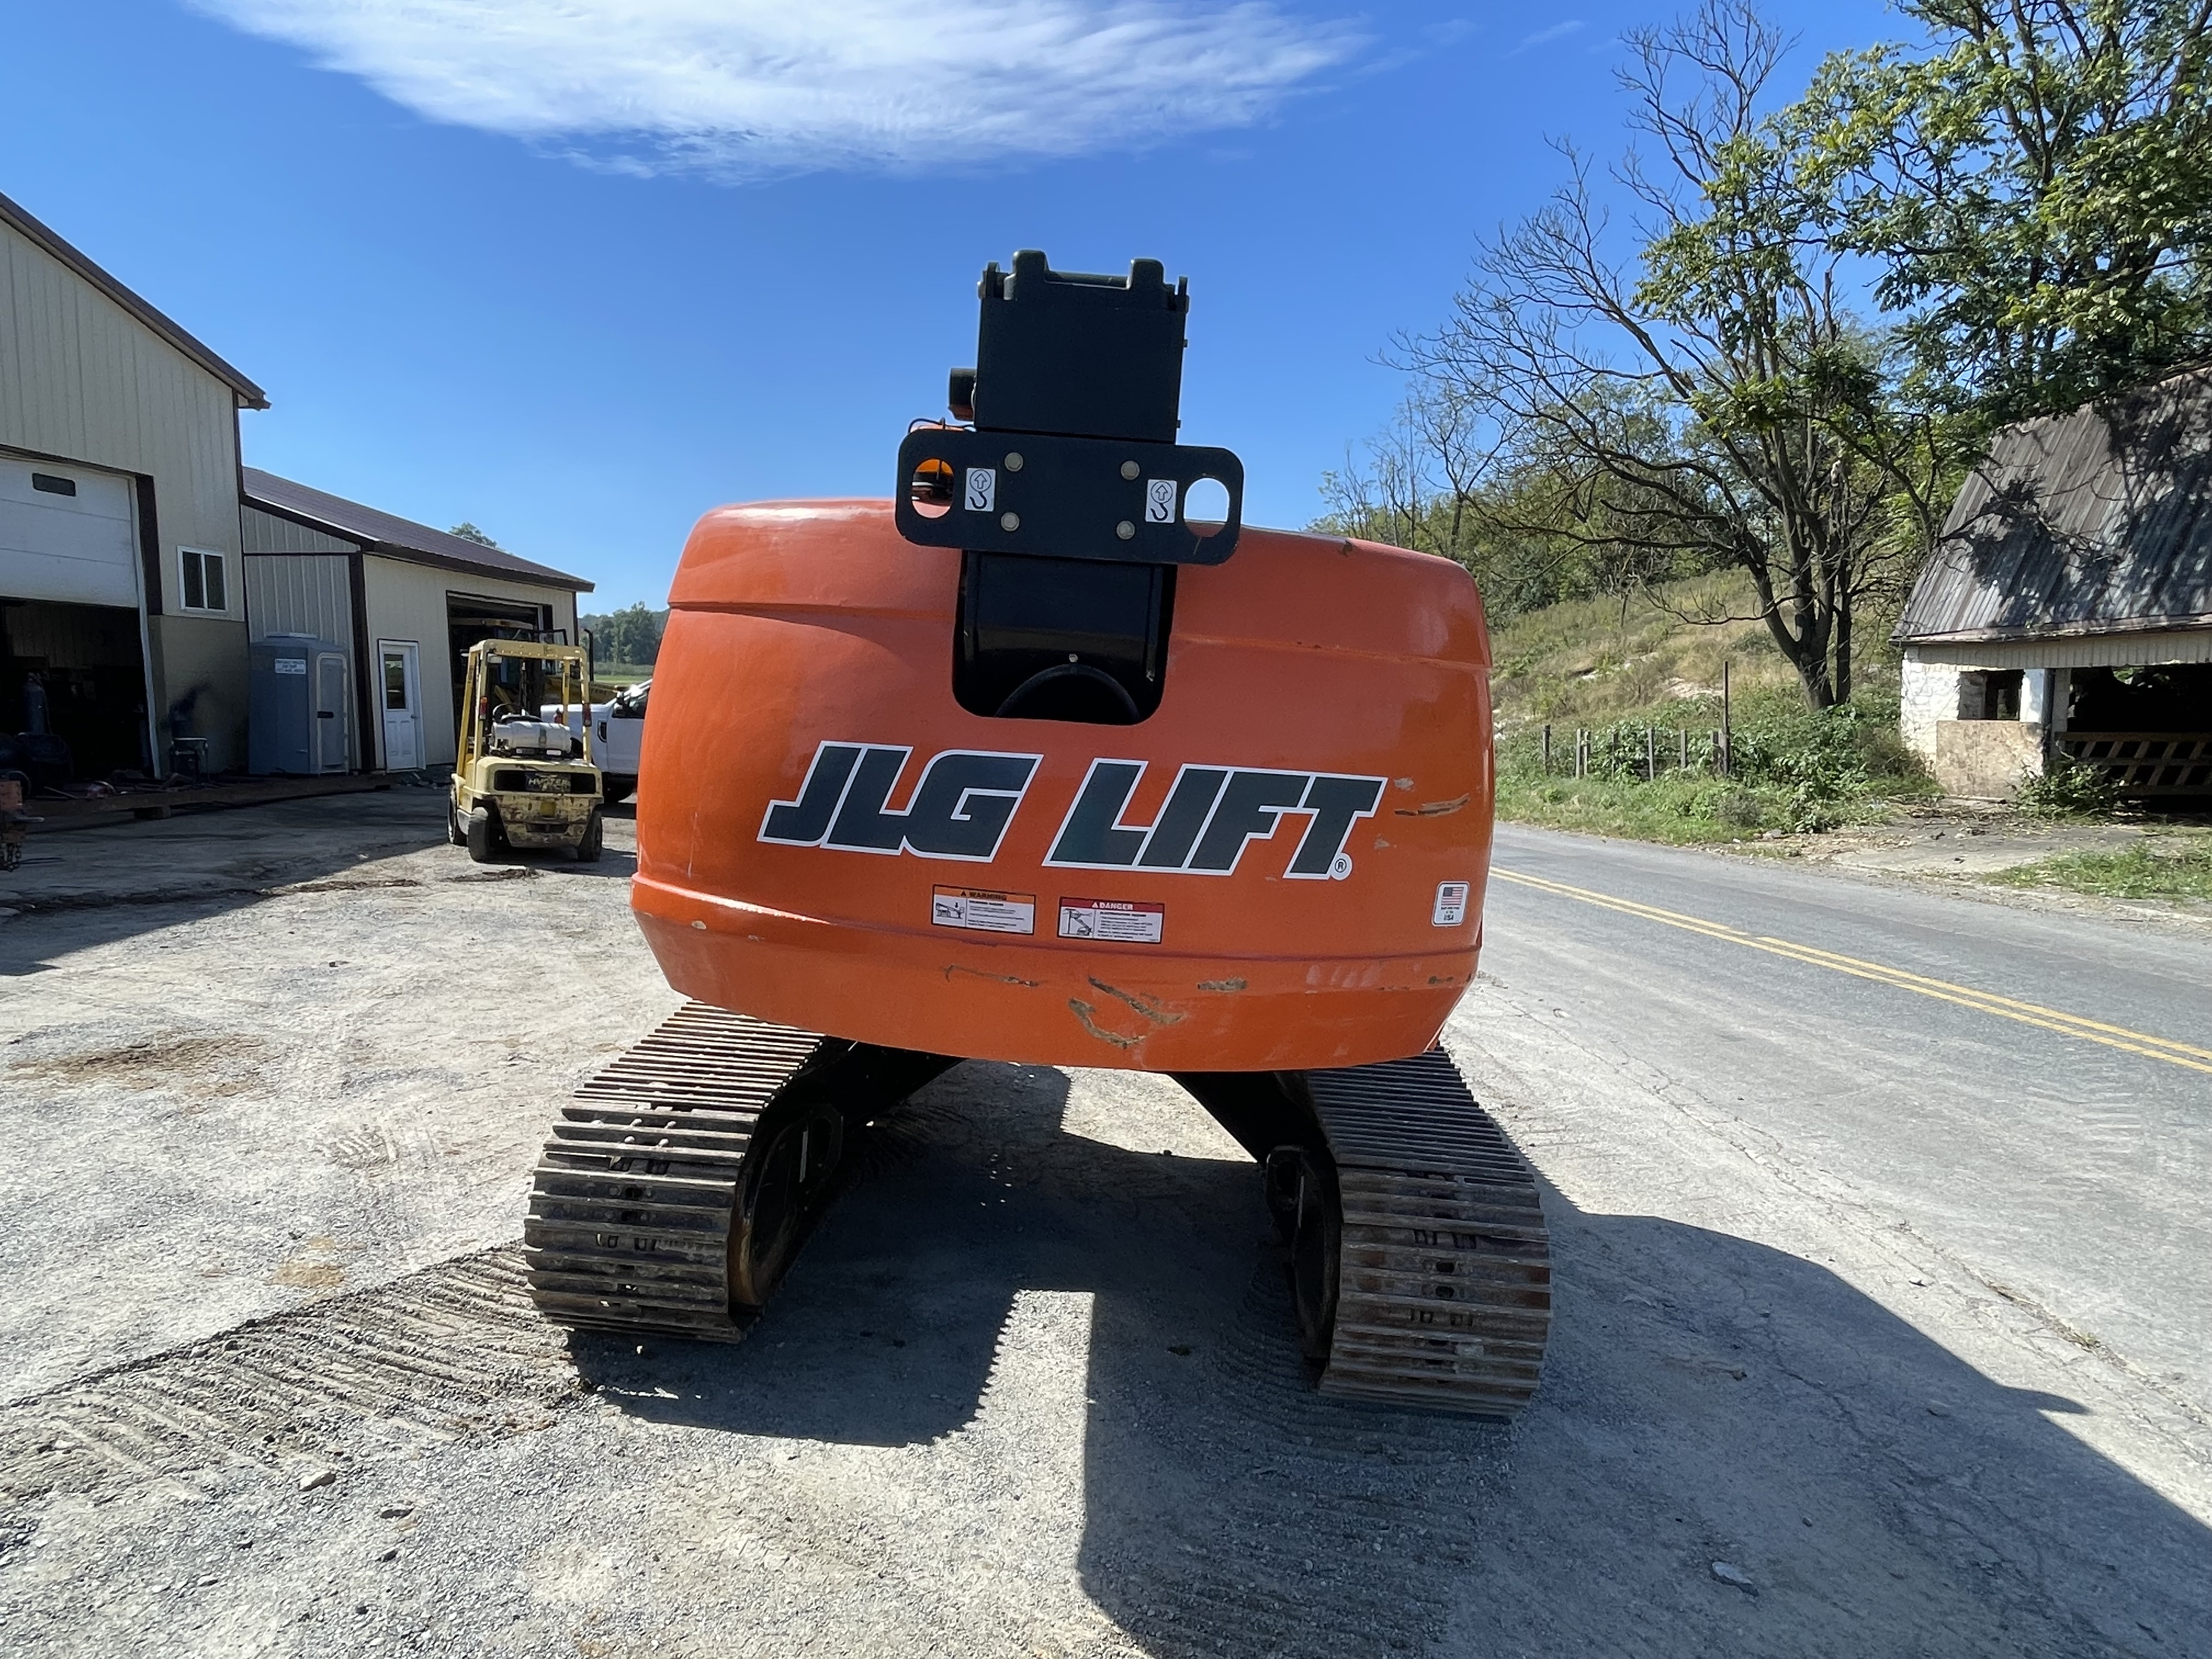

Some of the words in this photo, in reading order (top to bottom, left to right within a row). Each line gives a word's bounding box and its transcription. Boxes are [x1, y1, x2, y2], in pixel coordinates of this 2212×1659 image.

[757, 740, 1043, 862] JLG
[969, 891, 1007, 901] WARNING
[1099, 902, 1133, 910] DANGER
